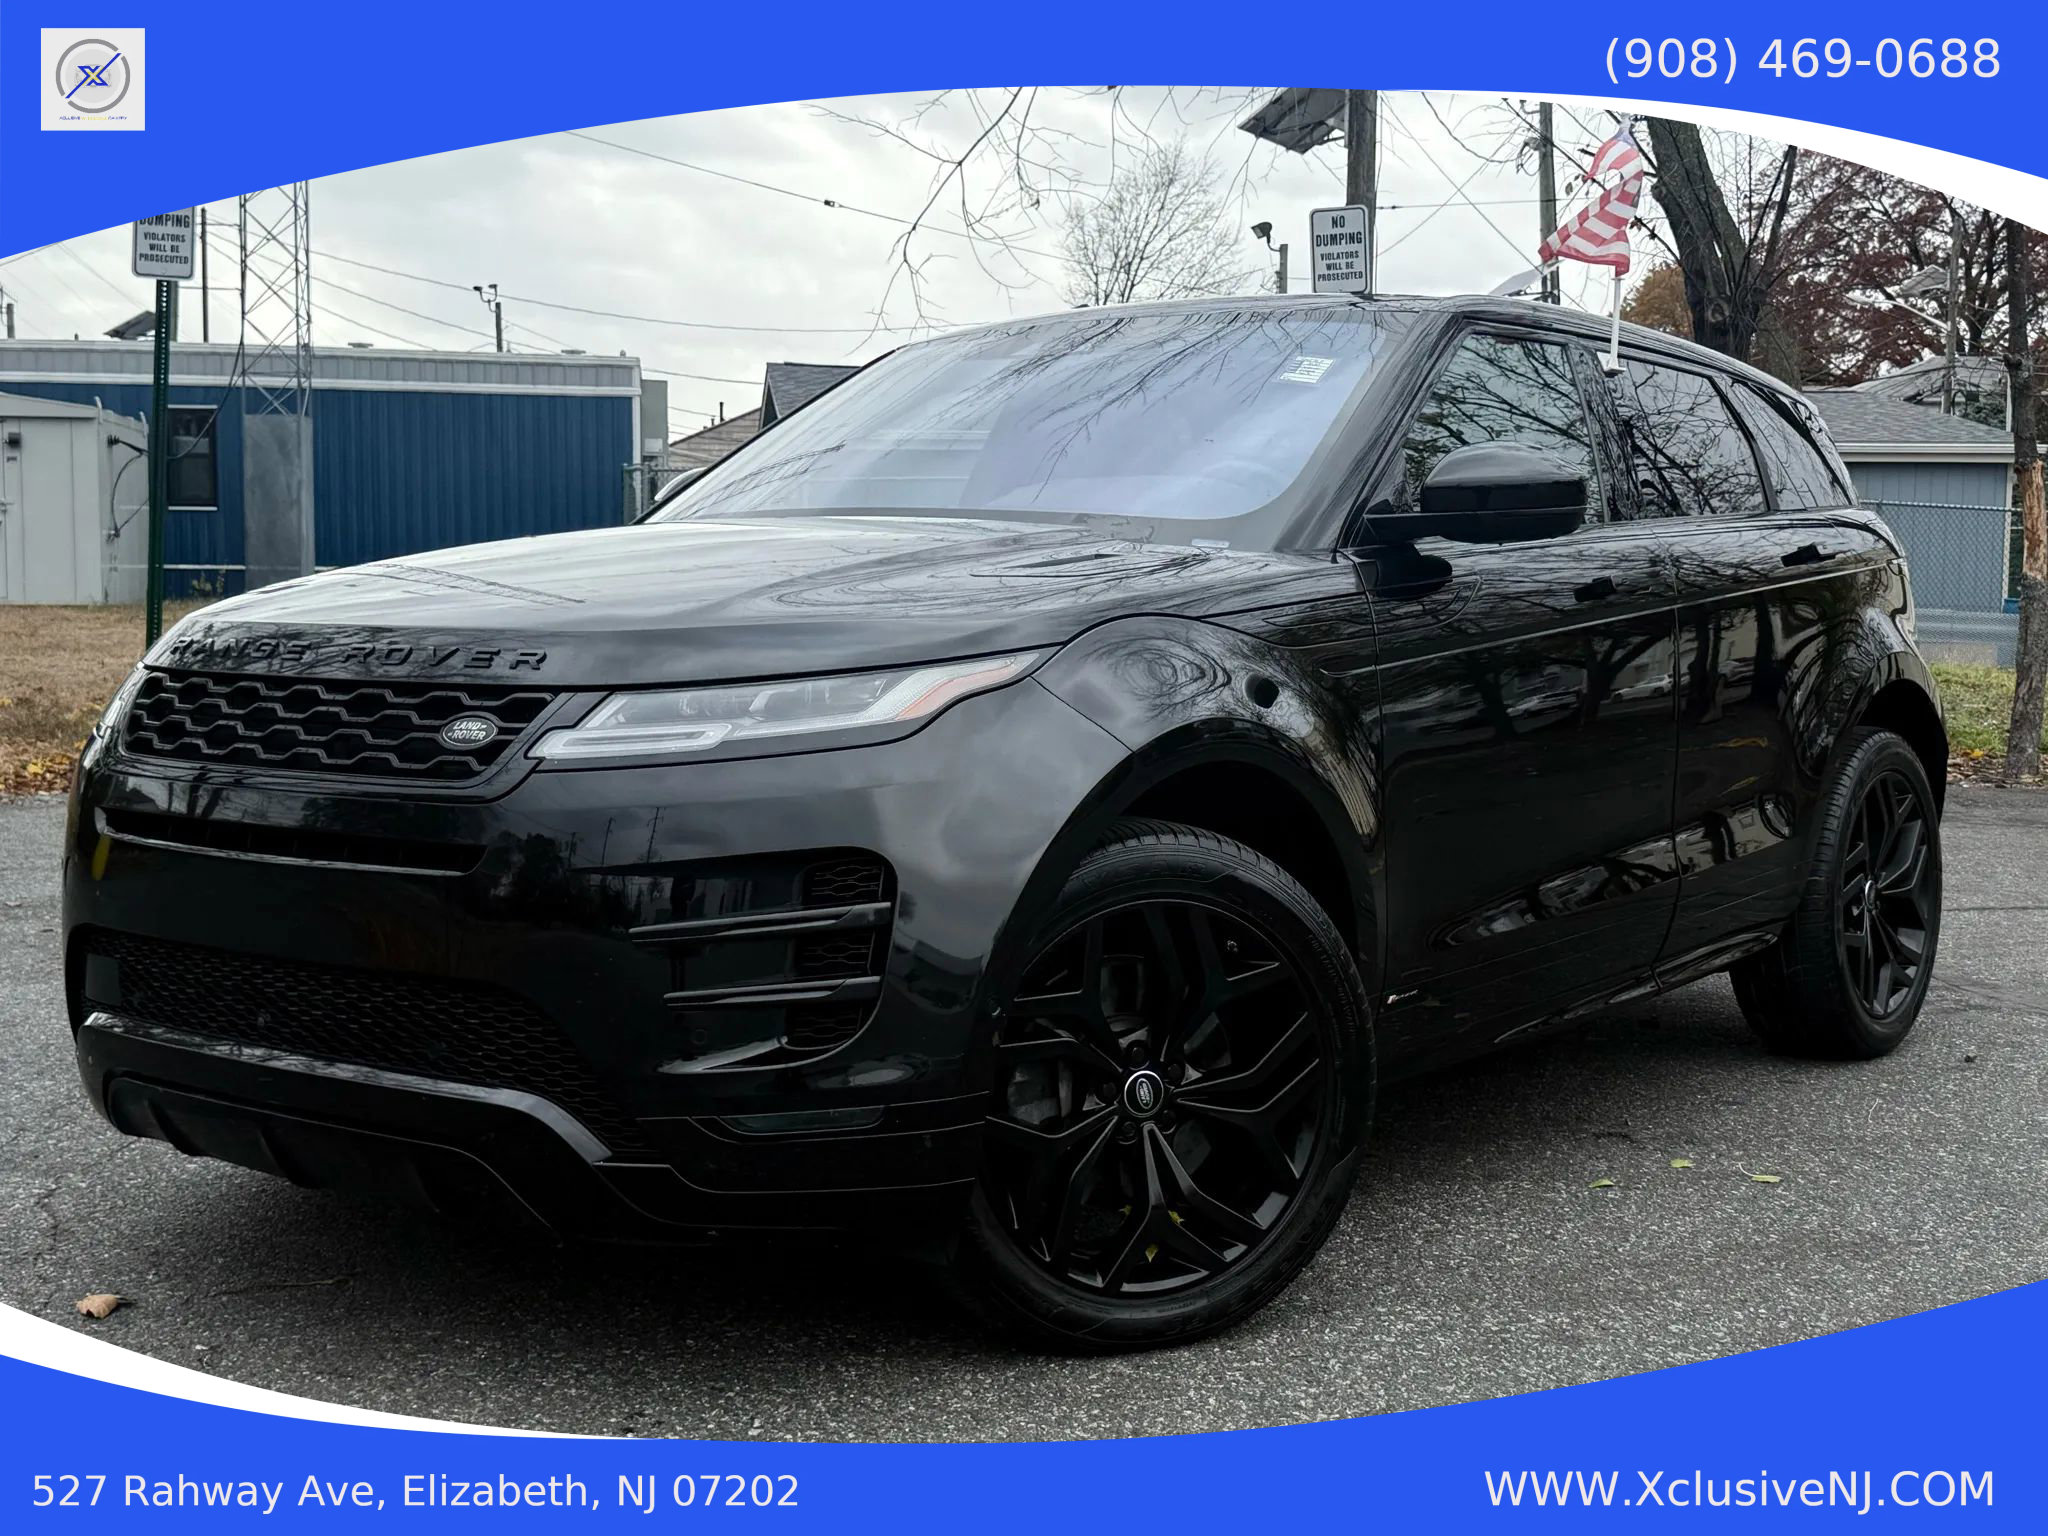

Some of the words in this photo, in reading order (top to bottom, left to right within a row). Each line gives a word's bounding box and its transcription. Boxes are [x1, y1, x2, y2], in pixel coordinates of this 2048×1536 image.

[1331, 215, 1346, 229] NO
[143, 231, 186, 243] VIOLATORS
[1315, 231, 1363, 247] DUMPING
[148, 243, 167, 253] WILL
[170, 244, 180, 254] BE
[138, 252, 189, 265] PROSECUTED
[1320, 250, 1360, 261] VIOLATORS
[1325, 261, 1343, 271] WILL
[1345, 261, 1355, 270] BE
[1317, 270, 1363, 282] PROSECUTED
[170, 635, 311, 662] RANGE
[341, 643, 547, 671] ROVER
